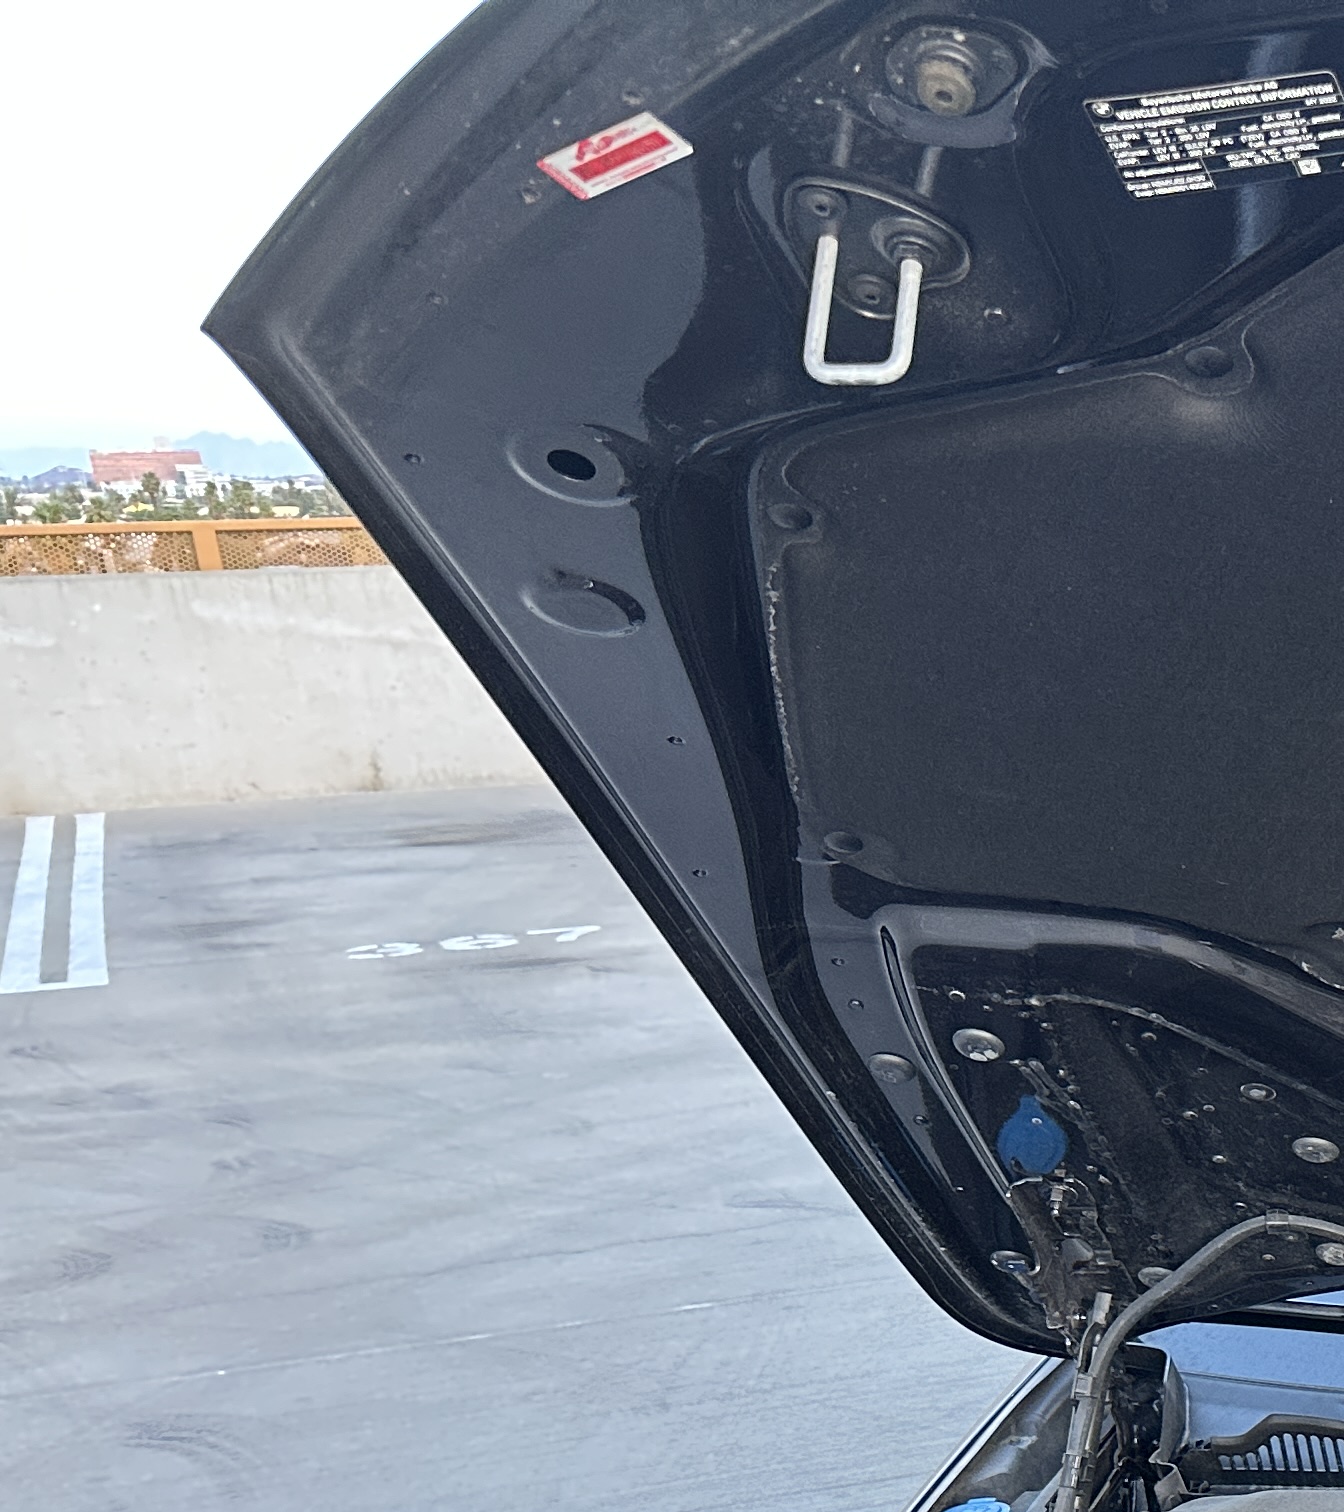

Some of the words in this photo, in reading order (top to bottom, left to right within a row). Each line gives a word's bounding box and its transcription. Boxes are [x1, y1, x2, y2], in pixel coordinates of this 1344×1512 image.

[1115, 107, 1160, 120] VEHICLE
[1159, 101, 1211, 116] EMISSION
[1211, 94, 1261, 109] CONTROL
[1260, 83, 1334, 102] INFORMATION
[1263, 81, 1278, 90] AG
[346, 925, 602, 959] 367
